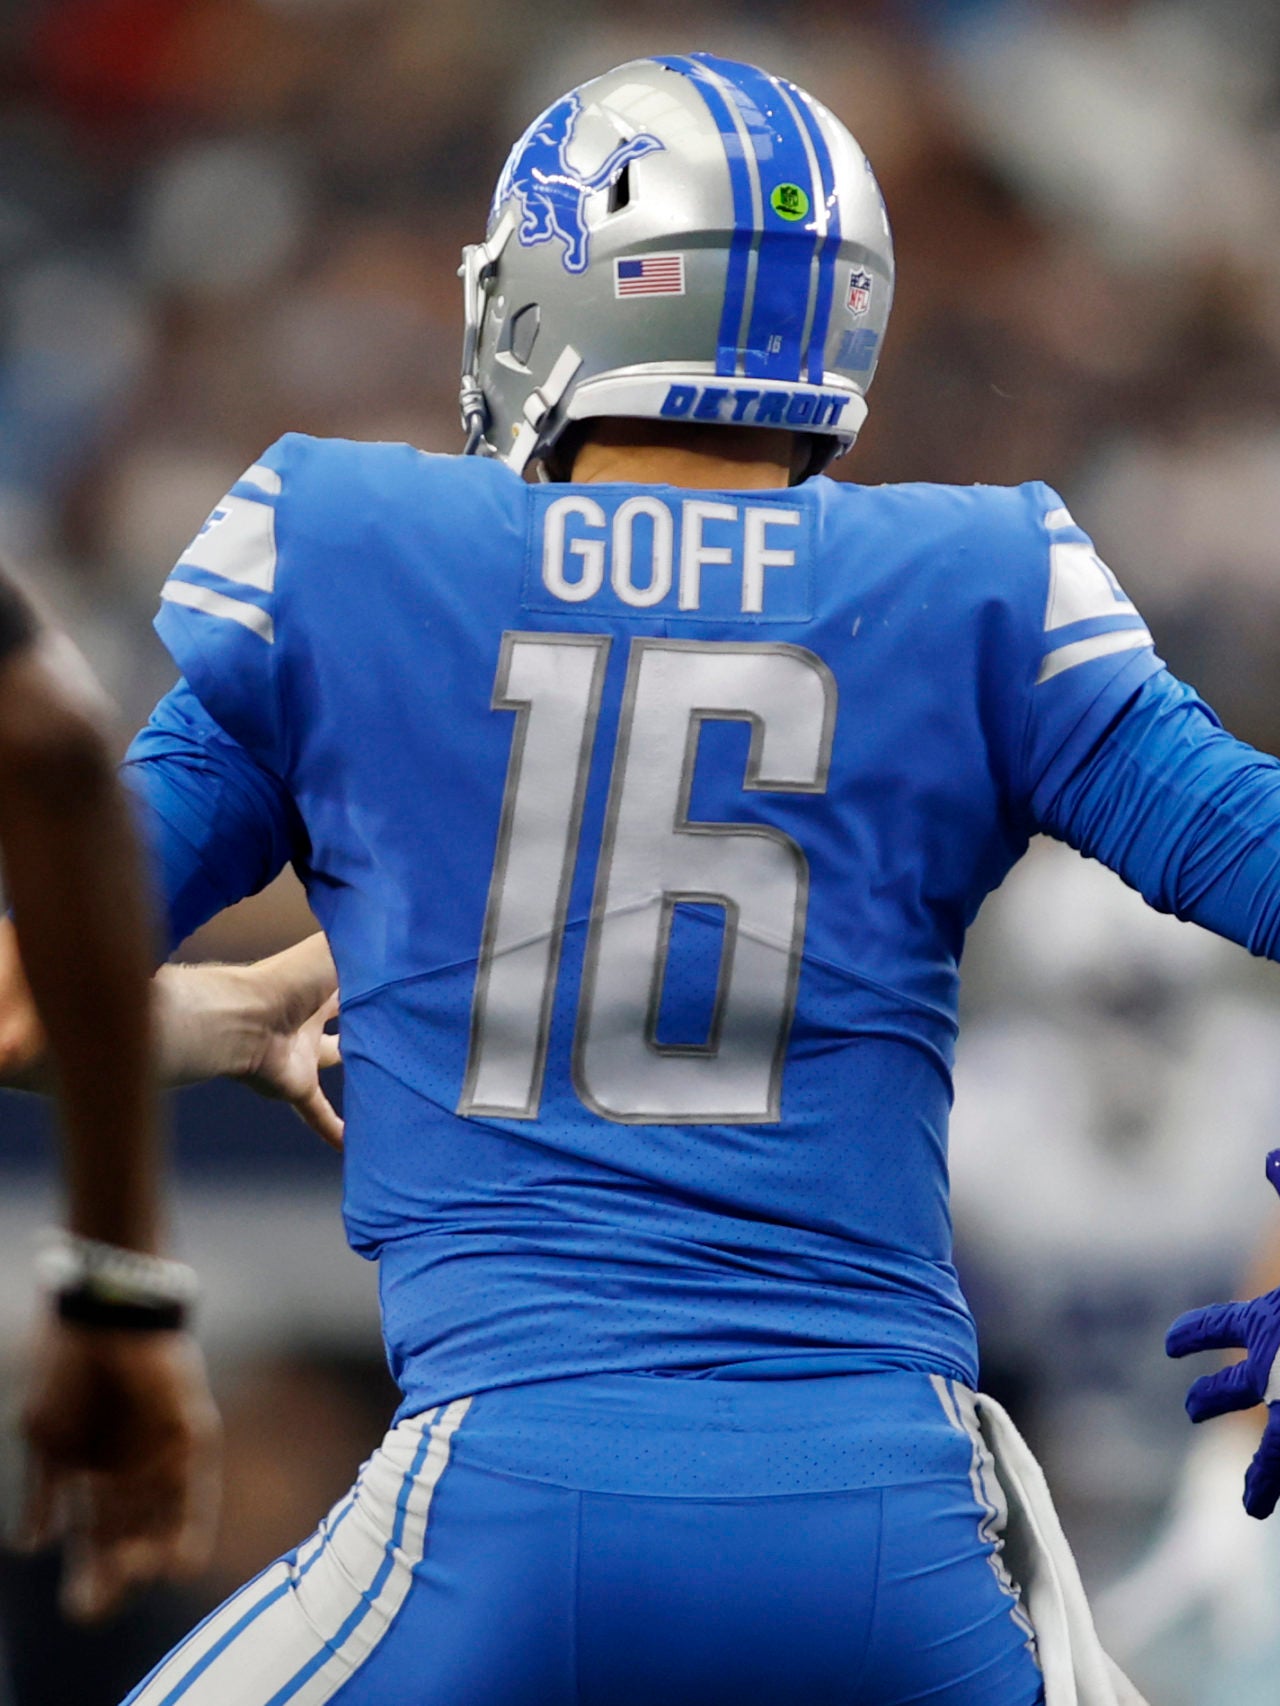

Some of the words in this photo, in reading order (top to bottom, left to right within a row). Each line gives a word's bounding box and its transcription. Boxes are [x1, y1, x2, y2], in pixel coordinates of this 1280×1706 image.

[660, 384, 850, 427] DETROIT
[542, 495, 800, 613] GOFF
[456, 631, 838, 1124] 16
